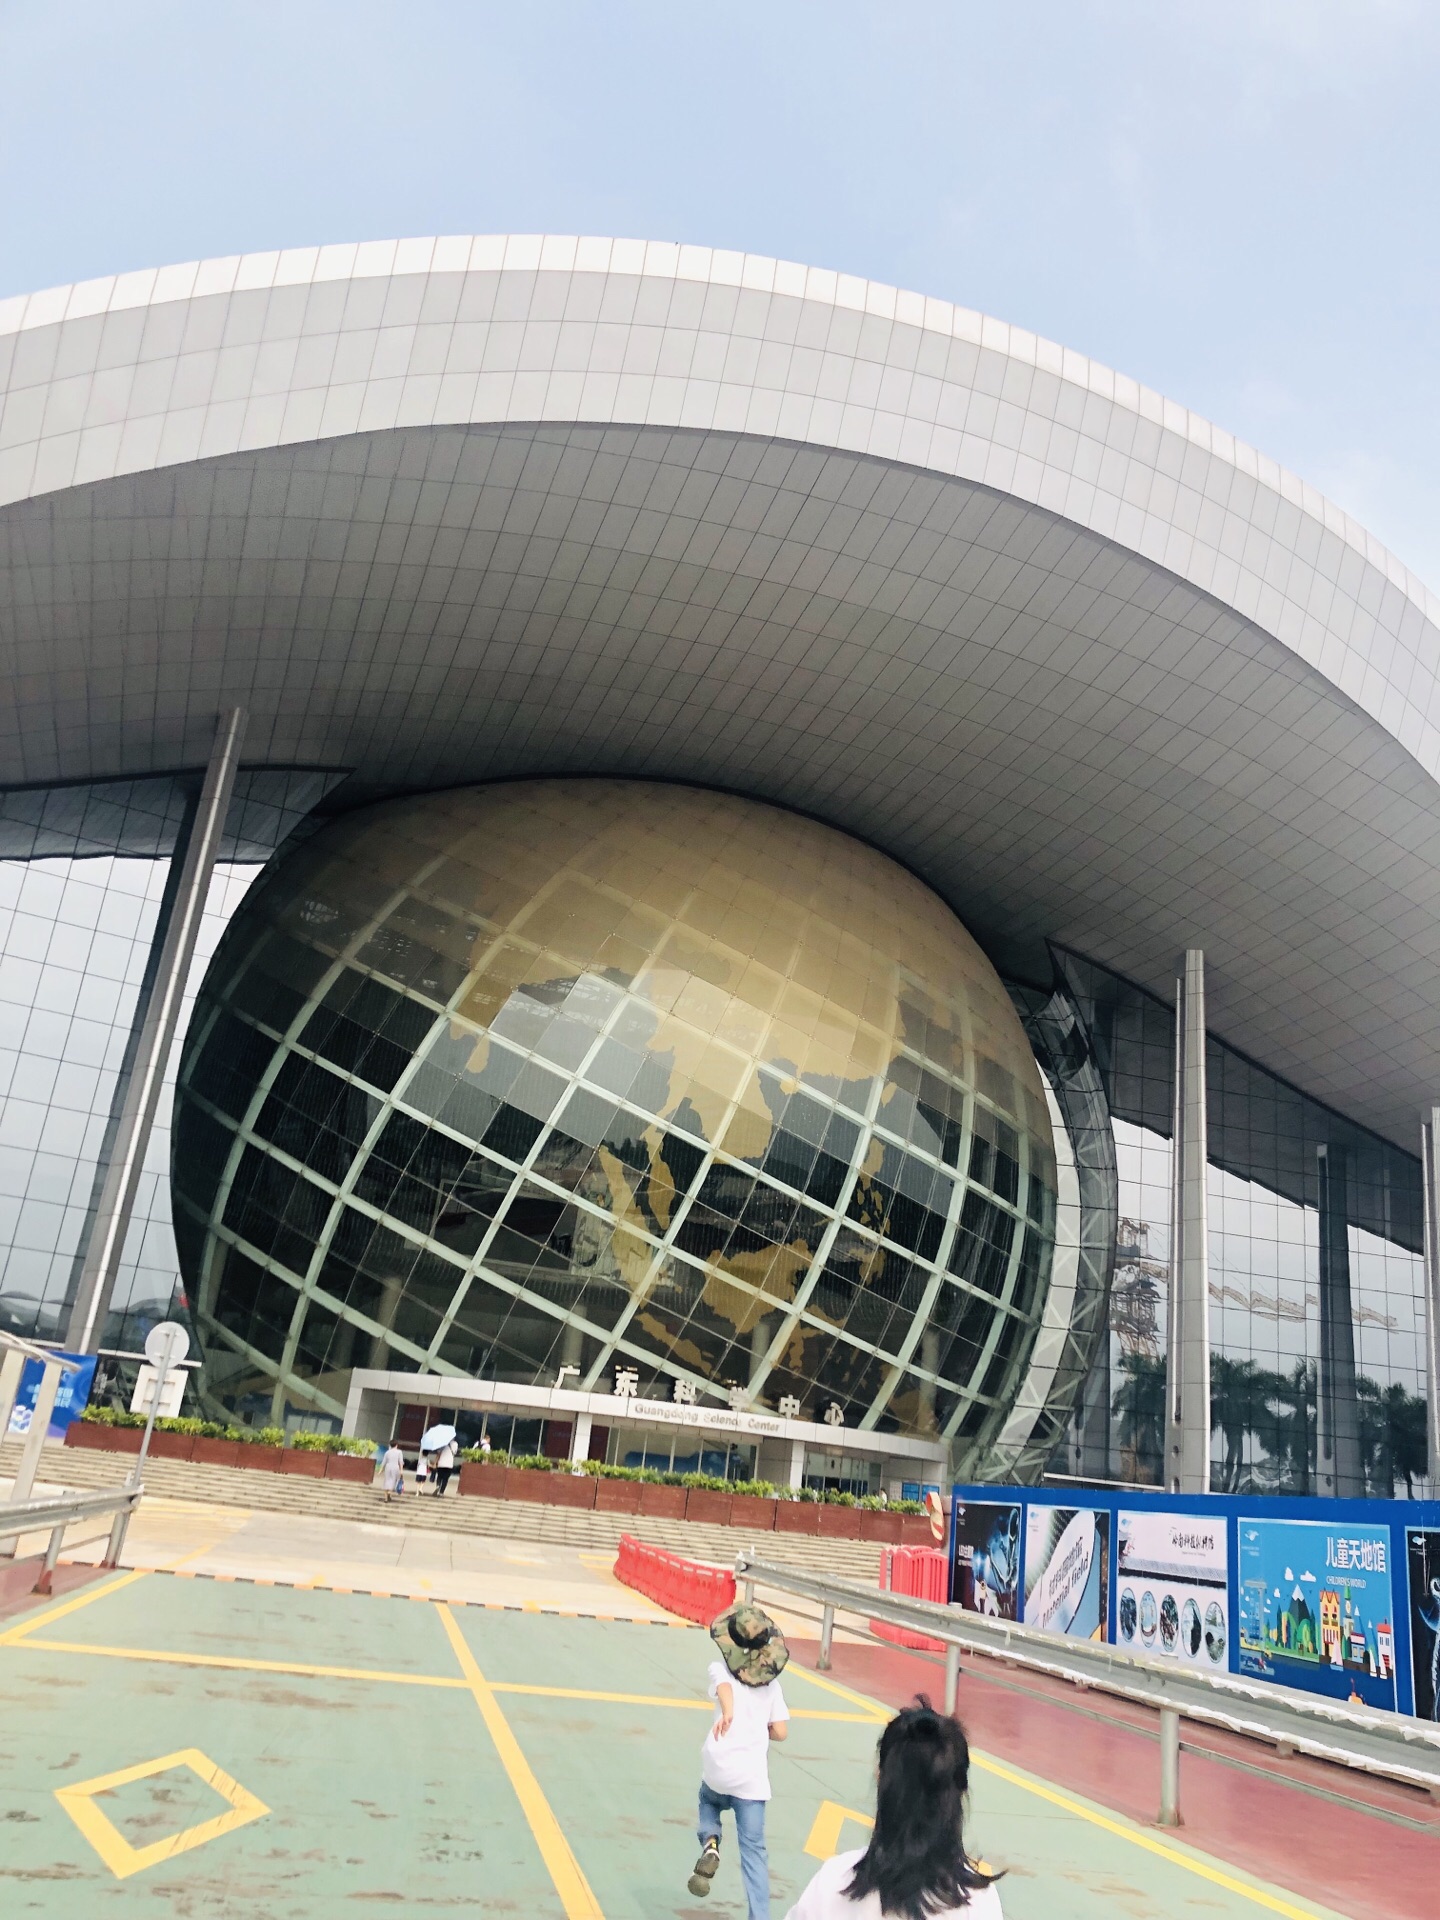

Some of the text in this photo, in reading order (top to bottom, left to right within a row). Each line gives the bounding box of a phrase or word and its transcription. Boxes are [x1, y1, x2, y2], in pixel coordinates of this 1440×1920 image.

[554, 1365, 844, 1426] 广东科学中心
[634, 1403, 699, 1422] Guangdong
[748, 1417, 780, 1432] Center
[1071, 1551, 1089, 1588] field
[1326, 1536, 1386, 1573] 儿童天地馆
